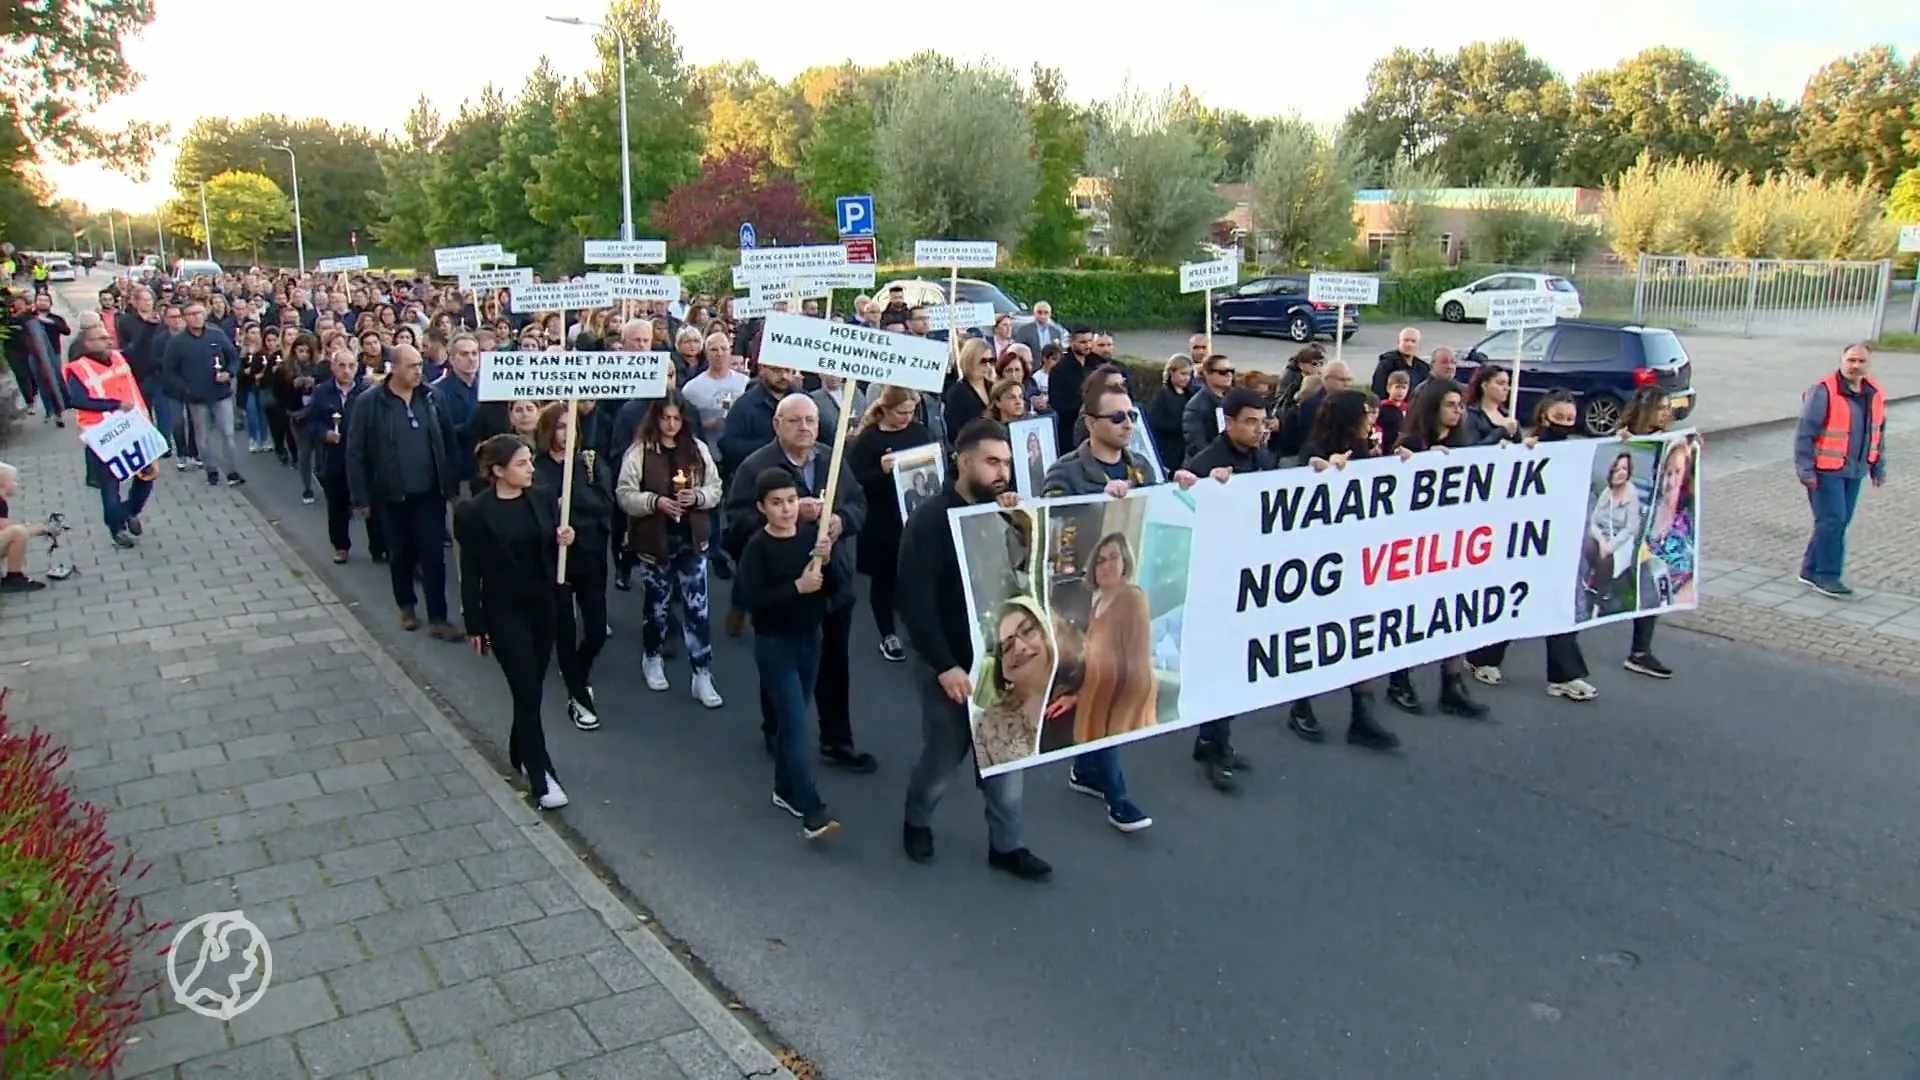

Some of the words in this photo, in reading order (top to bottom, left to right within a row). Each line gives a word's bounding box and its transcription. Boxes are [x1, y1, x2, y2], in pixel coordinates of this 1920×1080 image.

[845, 203, 865, 232] P
[629, 278, 660, 286] VEILIG
[761, 283, 786, 291] WAAR
[612, 287, 670, 296] EDERLAND?
[762, 293, 780, 301] NOG
[830, 325, 893, 346] HOEVEEL
[771, 332, 906, 365] WAARSCHUWINGEN
[909, 357, 941, 371] ZIJN
[494, 356, 525, 366] HOE
[530, 356, 560, 366] KAN
[565, 356, 592, 366] HET
[598, 355, 624, 365] DAT
[627, 355, 660, 365] ZO'N
[818, 357, 837, 370] ER
[840, 362, 892, 379] NODIG?
[492, 371, 525, 381] MAN
[531, 370, 587, 381] TUSSEN
[592, 370, 658, 380] NORMALE
[514, 386, 574, 396] MENSEN
[578, 384, 636, 394] WOONT?
[1260, 474, 1397, 535] WAAR
[1410, 462, 1494, 512] BEN
[1506, 458, 1551, 499] IK
[1236, 551, 1343, 613] NOG
[1362, 524, 1492, 586] VEILIG
[1506, 519, 1550, 560] IN
[1248, 581, 1530, 683] NEDERLAND?
